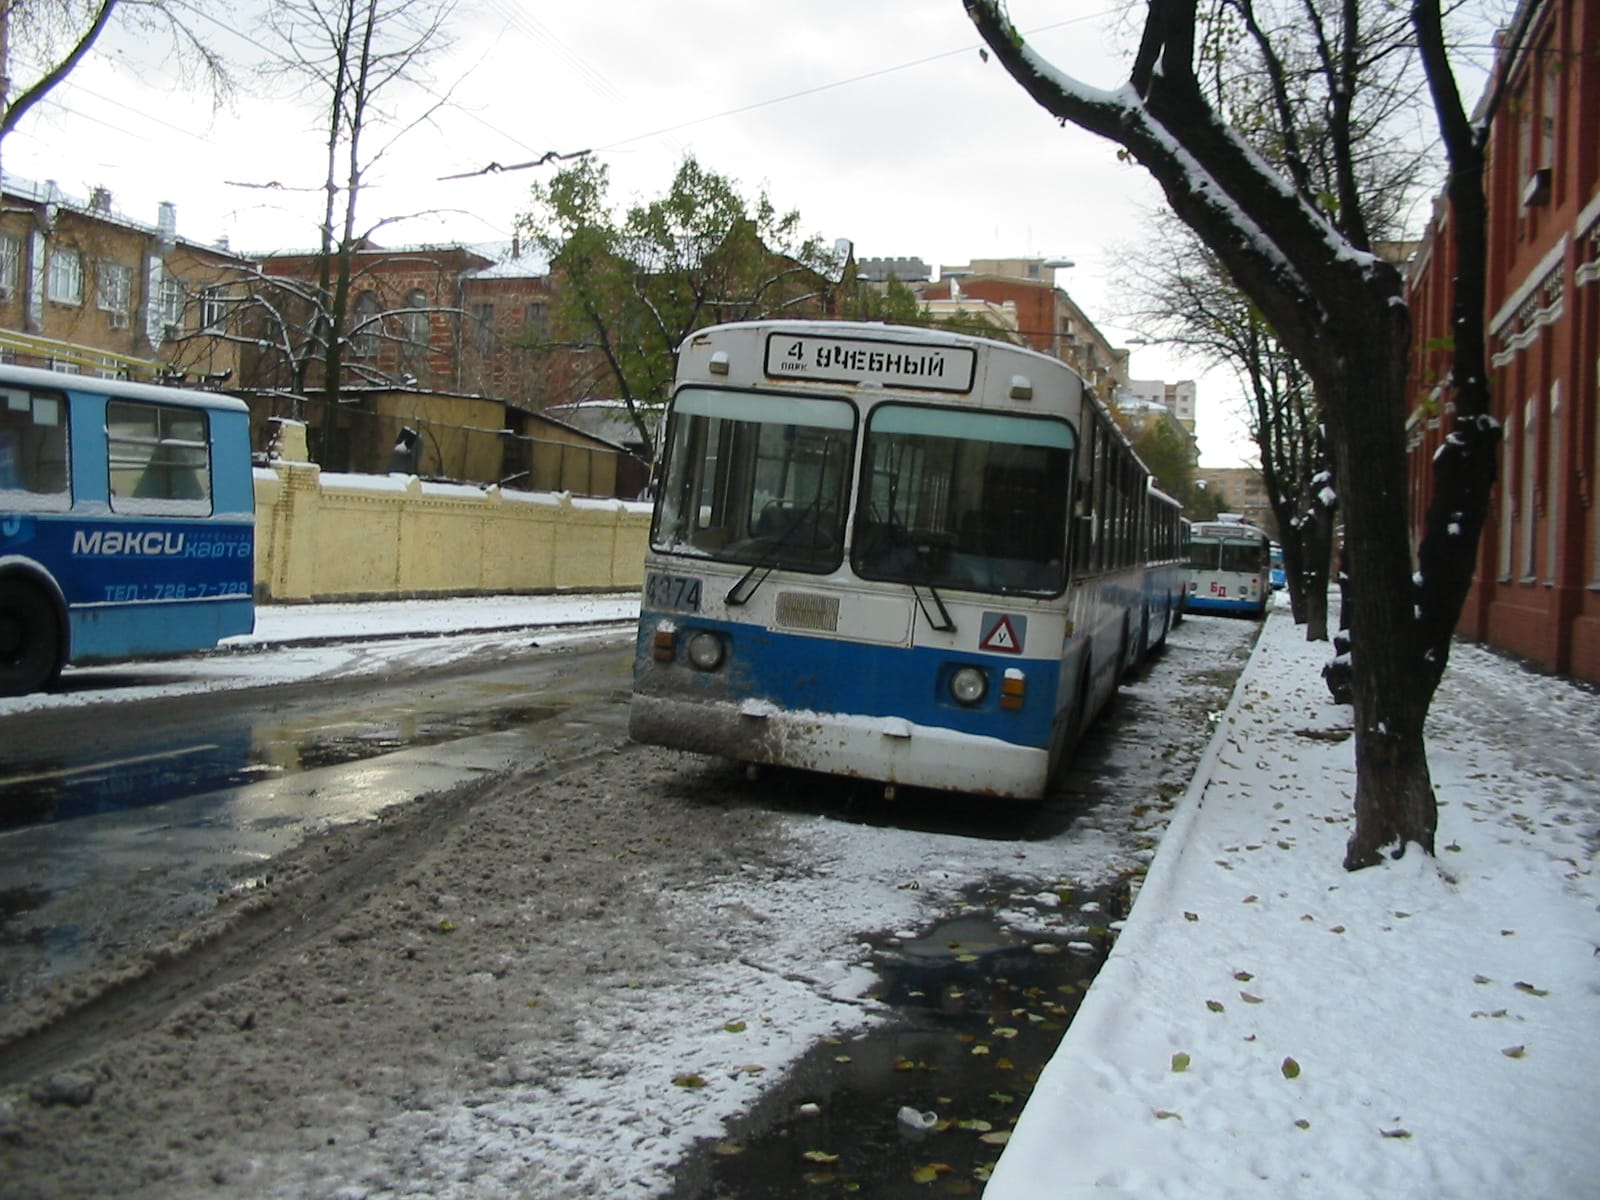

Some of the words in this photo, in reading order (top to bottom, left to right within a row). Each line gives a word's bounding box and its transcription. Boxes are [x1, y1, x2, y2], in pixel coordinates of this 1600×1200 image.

[781, 361, 807, 372] ПАРК
[788, 341, 803, 361] 4
[816, 346, 944, 377] УЧЕБНЫЙ
